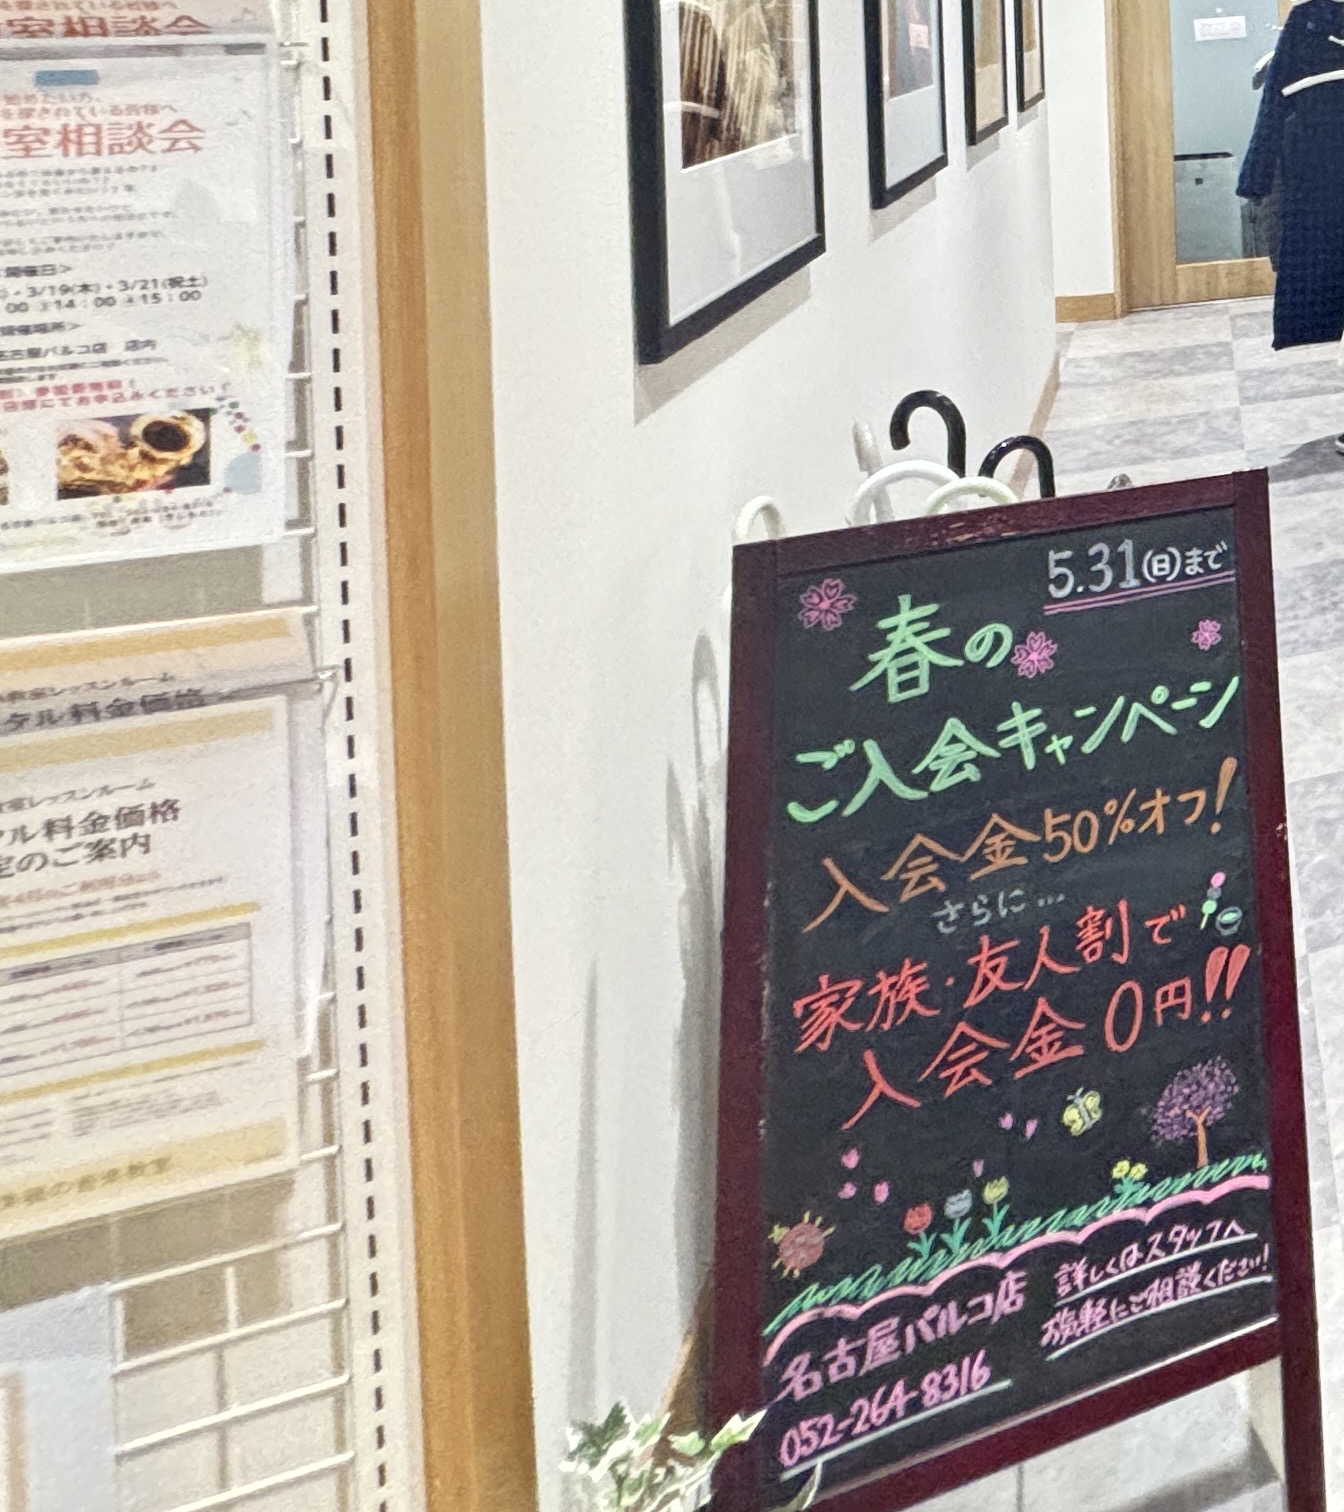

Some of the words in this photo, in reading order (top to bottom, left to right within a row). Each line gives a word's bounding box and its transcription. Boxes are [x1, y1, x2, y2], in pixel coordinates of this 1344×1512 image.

[1048, 540, 1229, 600] 5.31(日)まで
[849, 594, 1013, 704] 春の
[787, 676, 1241, 823] ご入会キャンペーン
[0, 798, 182, 846] ル料金価格
[802, 757, 1238, 933] 入会金50%オフ!
[792, 899, 1186, 1053] 家族・友人割で
[774, 1270, 1027, 1402] 名古屋パルコ店
[780, 1348, 992, 1468] 052-264-8316
